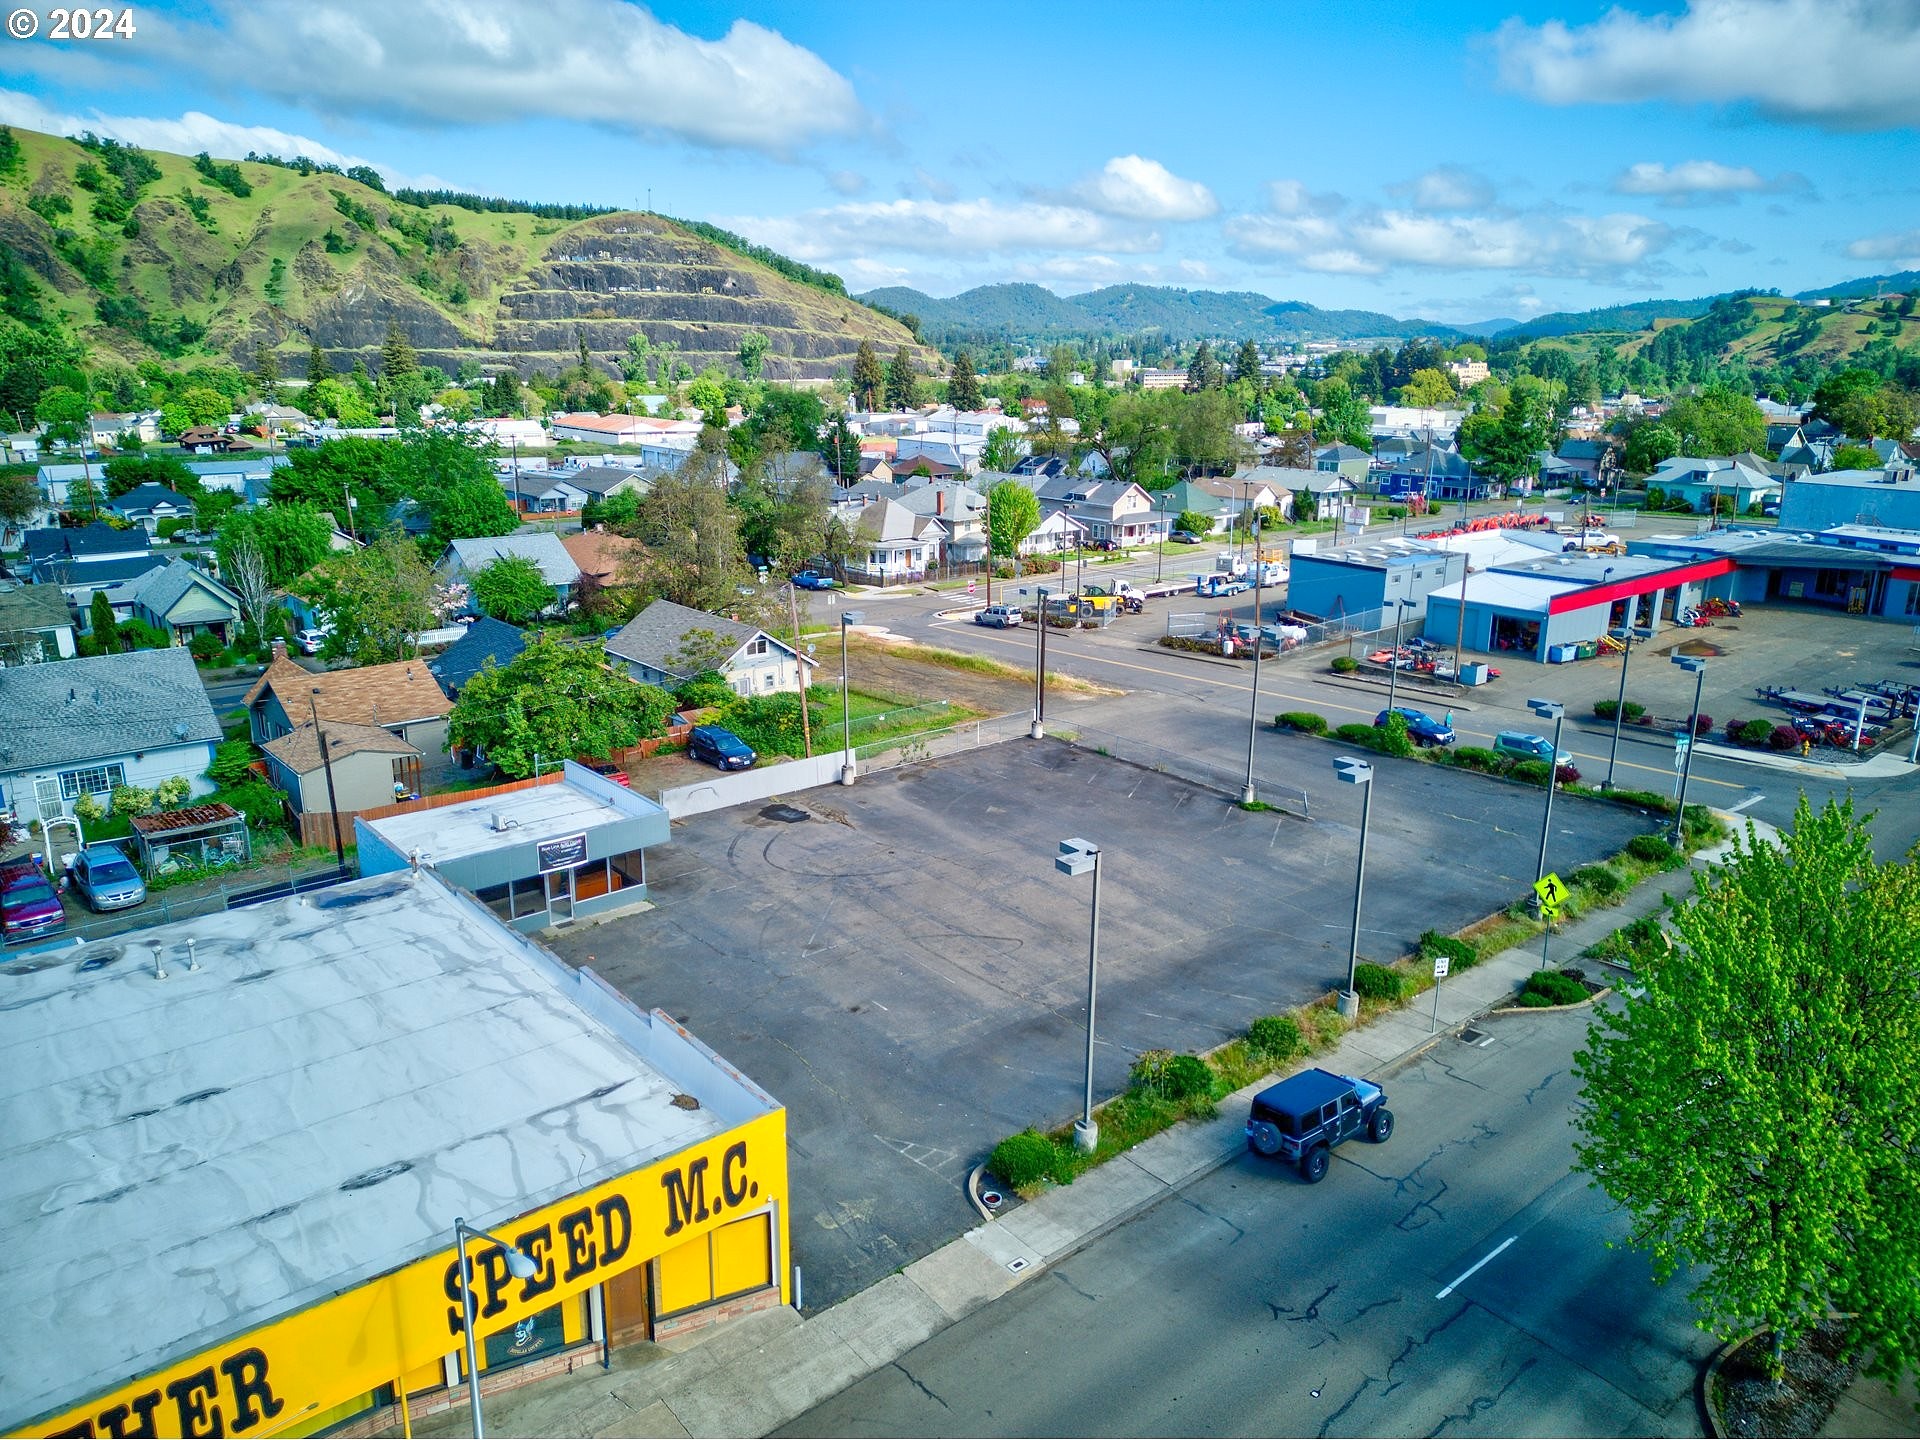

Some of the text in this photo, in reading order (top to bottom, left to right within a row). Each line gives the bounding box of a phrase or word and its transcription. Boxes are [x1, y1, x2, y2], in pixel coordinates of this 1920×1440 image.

[43, 1141, 758, 1439] HER SPEED M.C.
